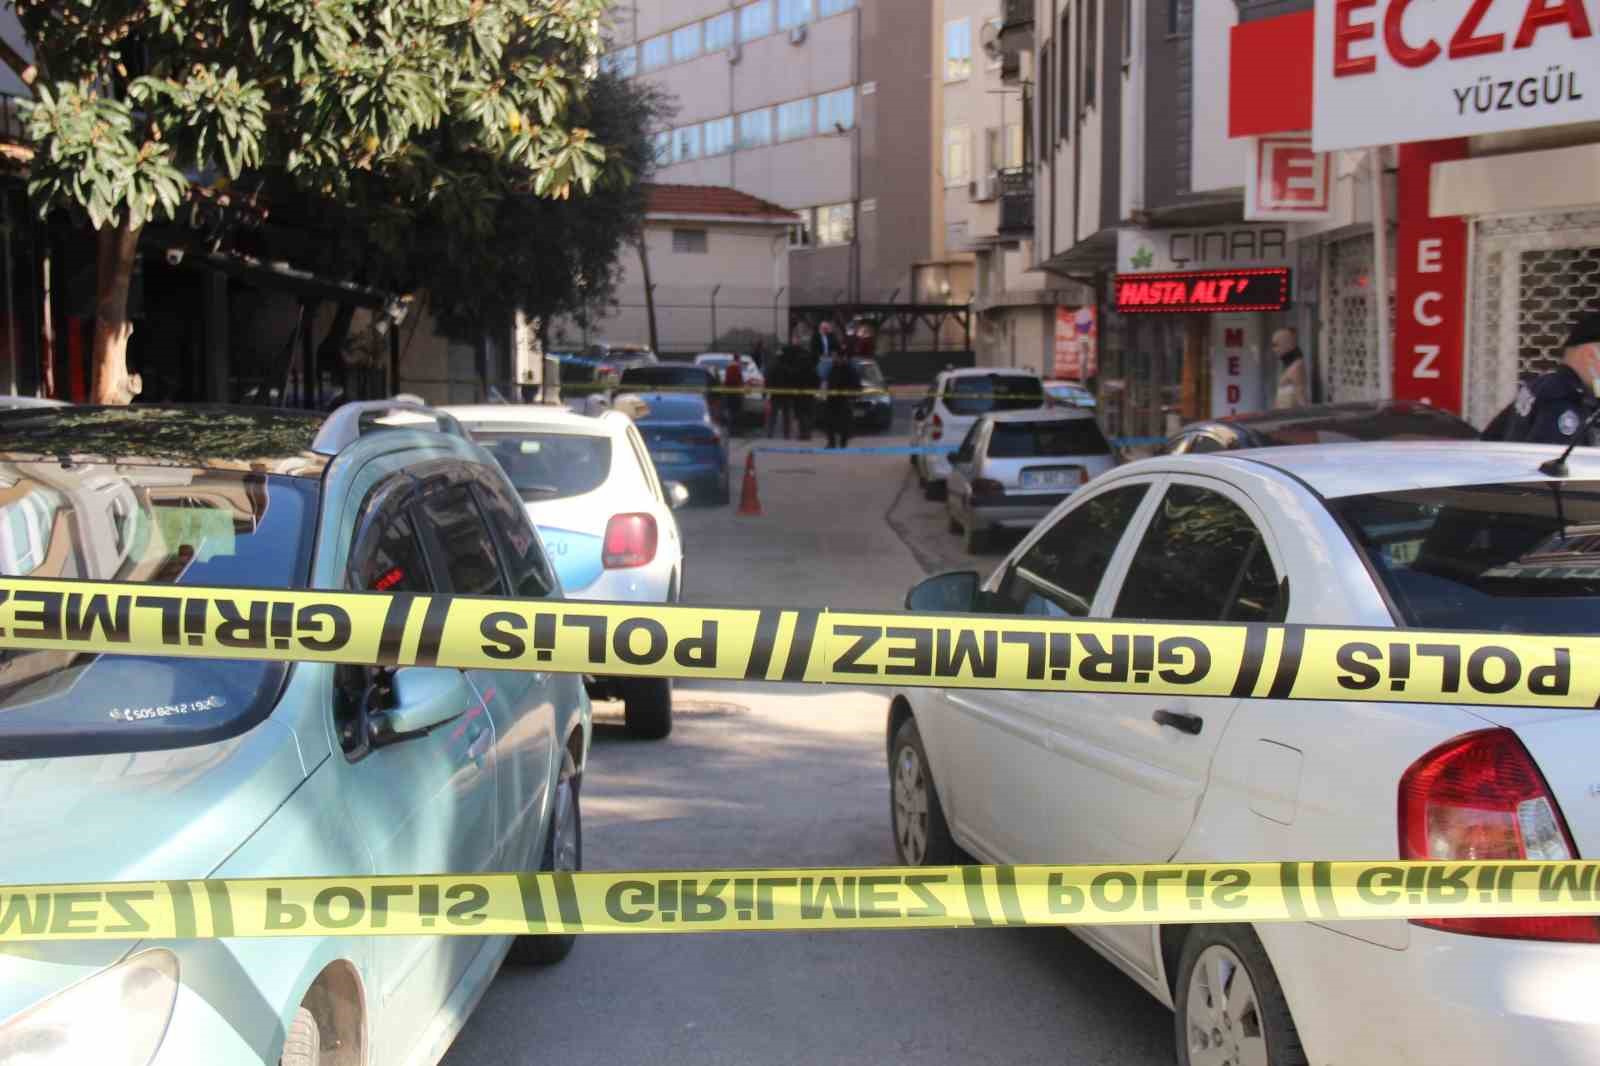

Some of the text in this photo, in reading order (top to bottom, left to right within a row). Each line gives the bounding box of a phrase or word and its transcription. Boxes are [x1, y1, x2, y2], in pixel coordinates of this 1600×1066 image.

[1453, 64, 1583, 115] YÜZGÜL
[1272, 148, 1316, 201] E
[1119, 281, 1187, 305] HASTA
[1412, 239, 1443, 404] ECZ
[1225, 327, 1243, 414] MED
[0, 589, 1571, 697] POLİS GİRİLMEZ POLİS GİRİLME
